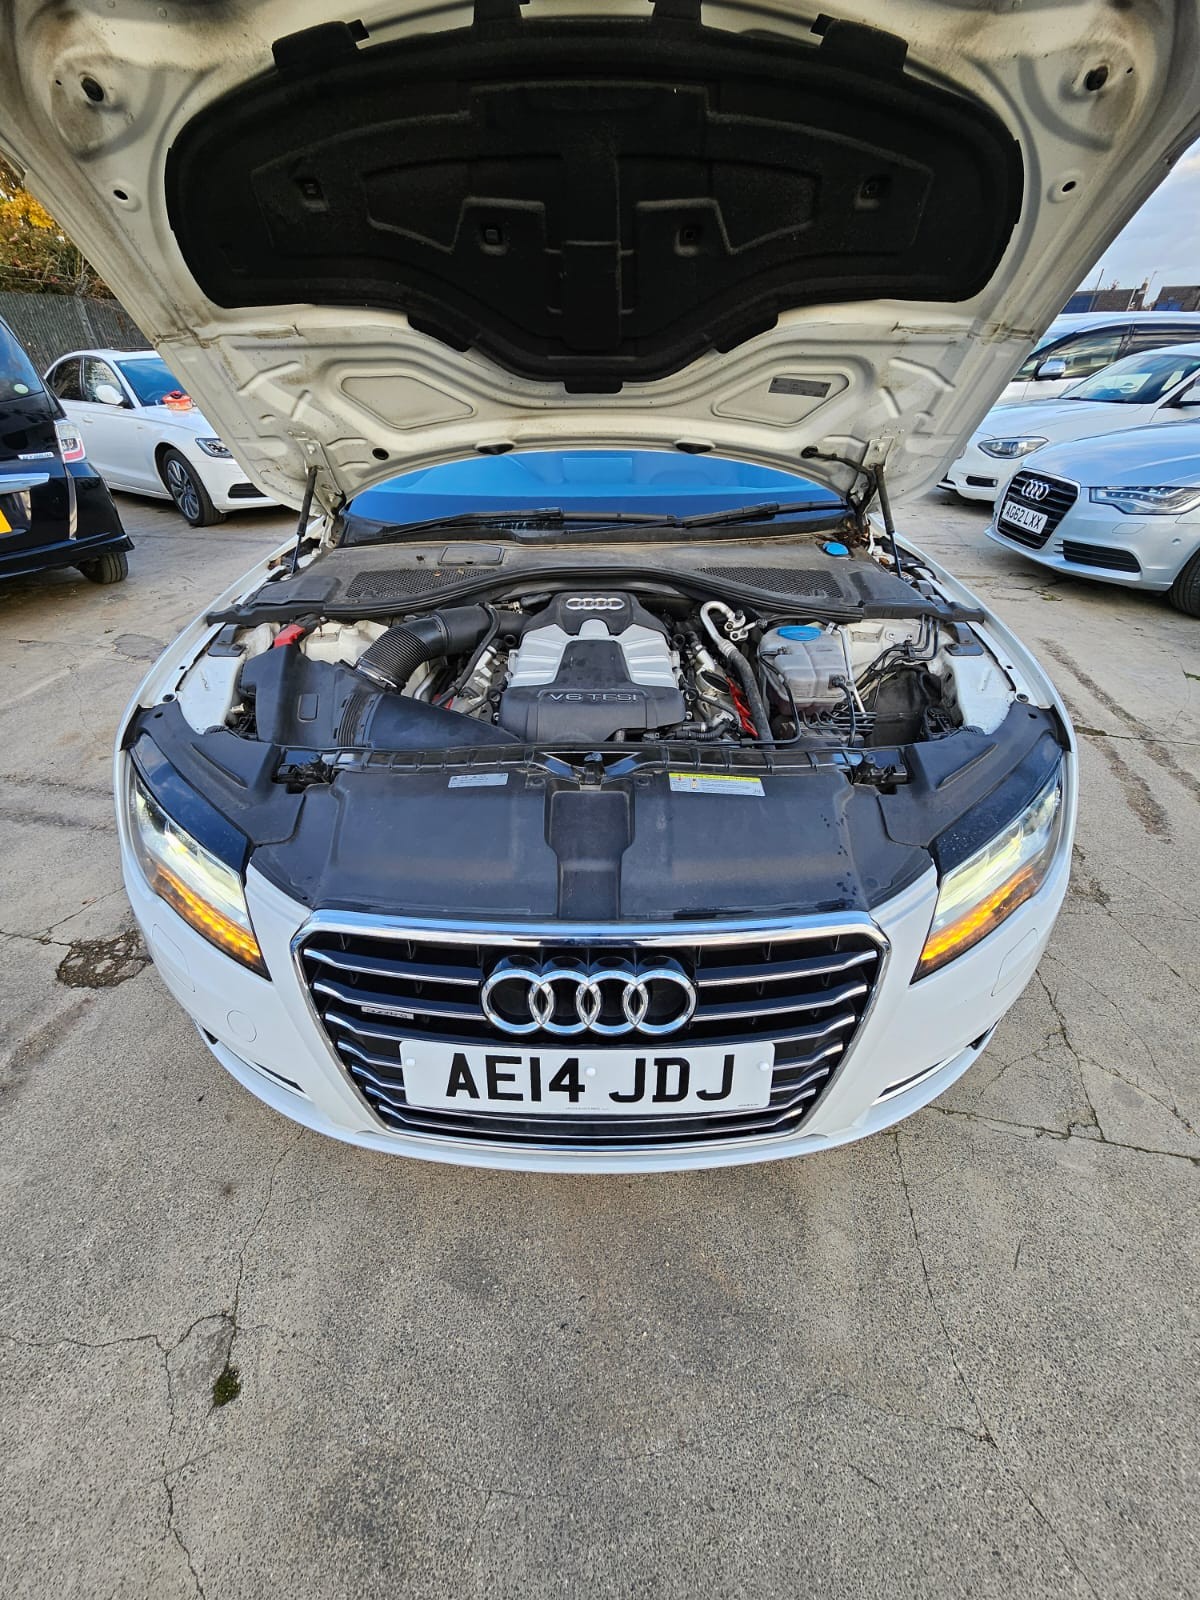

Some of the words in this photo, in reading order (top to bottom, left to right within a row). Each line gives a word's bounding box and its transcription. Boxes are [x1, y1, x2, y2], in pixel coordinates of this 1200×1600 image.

[1005, 504, 1025, 522] AG62
[1023, 511, 1043, 529] LXX
[550, 693, 583, 702] V6
[587, 693, 637, 702] TFSI
[446, 1053, 585, 1102] AE14
[608, 1054, 735, 1103] JDJ
